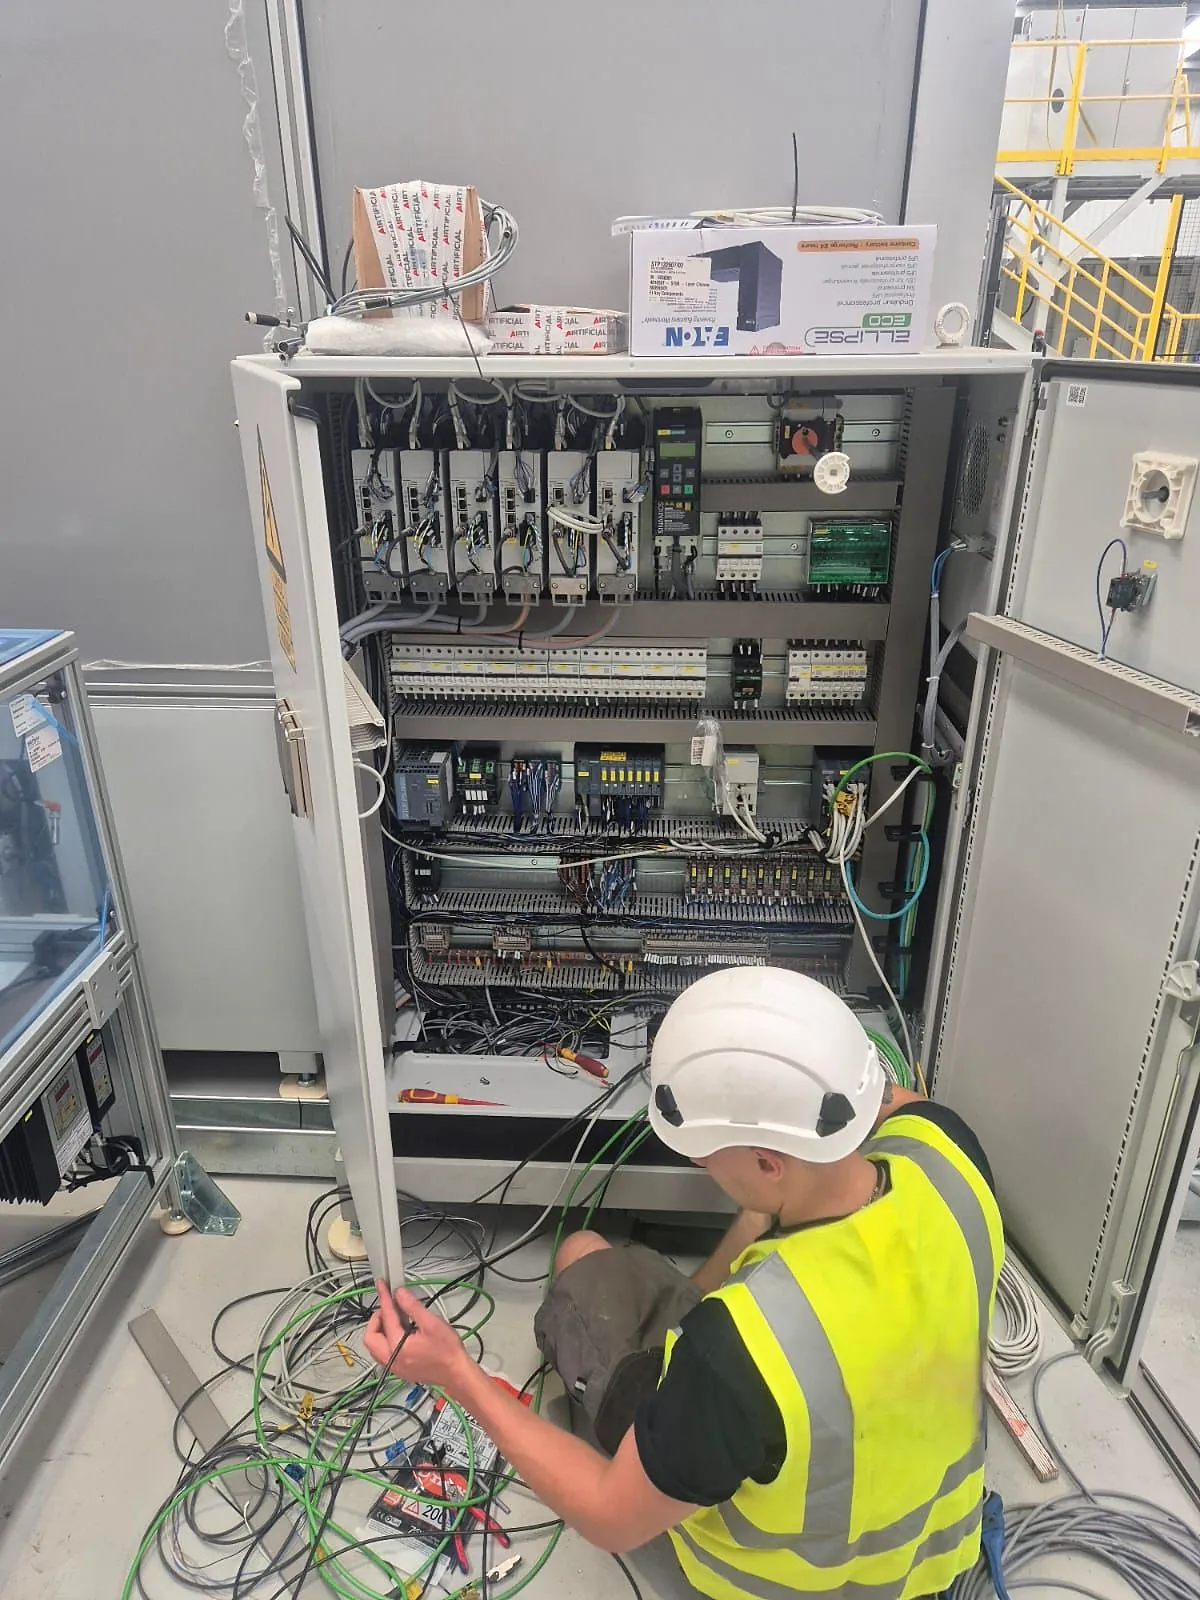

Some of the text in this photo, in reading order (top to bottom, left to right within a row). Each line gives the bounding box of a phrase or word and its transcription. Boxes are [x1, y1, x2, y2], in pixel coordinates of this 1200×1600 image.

[412, 193, 426, 242] AIRTIFICIAL
[442, 194, 452, 245] AIRTIFICIAL
[430, 226, 439, 277] AIRTIFICIAL
[453, 229, 462, 278] AIRTIFICIAL
[565, 327, 608, 337] AIRTIFICIAL
[665, 326, 729, 347] EATON
[814, 330, 911, 344] ELLIPSE
[869, 315, 906, 326] ECO
